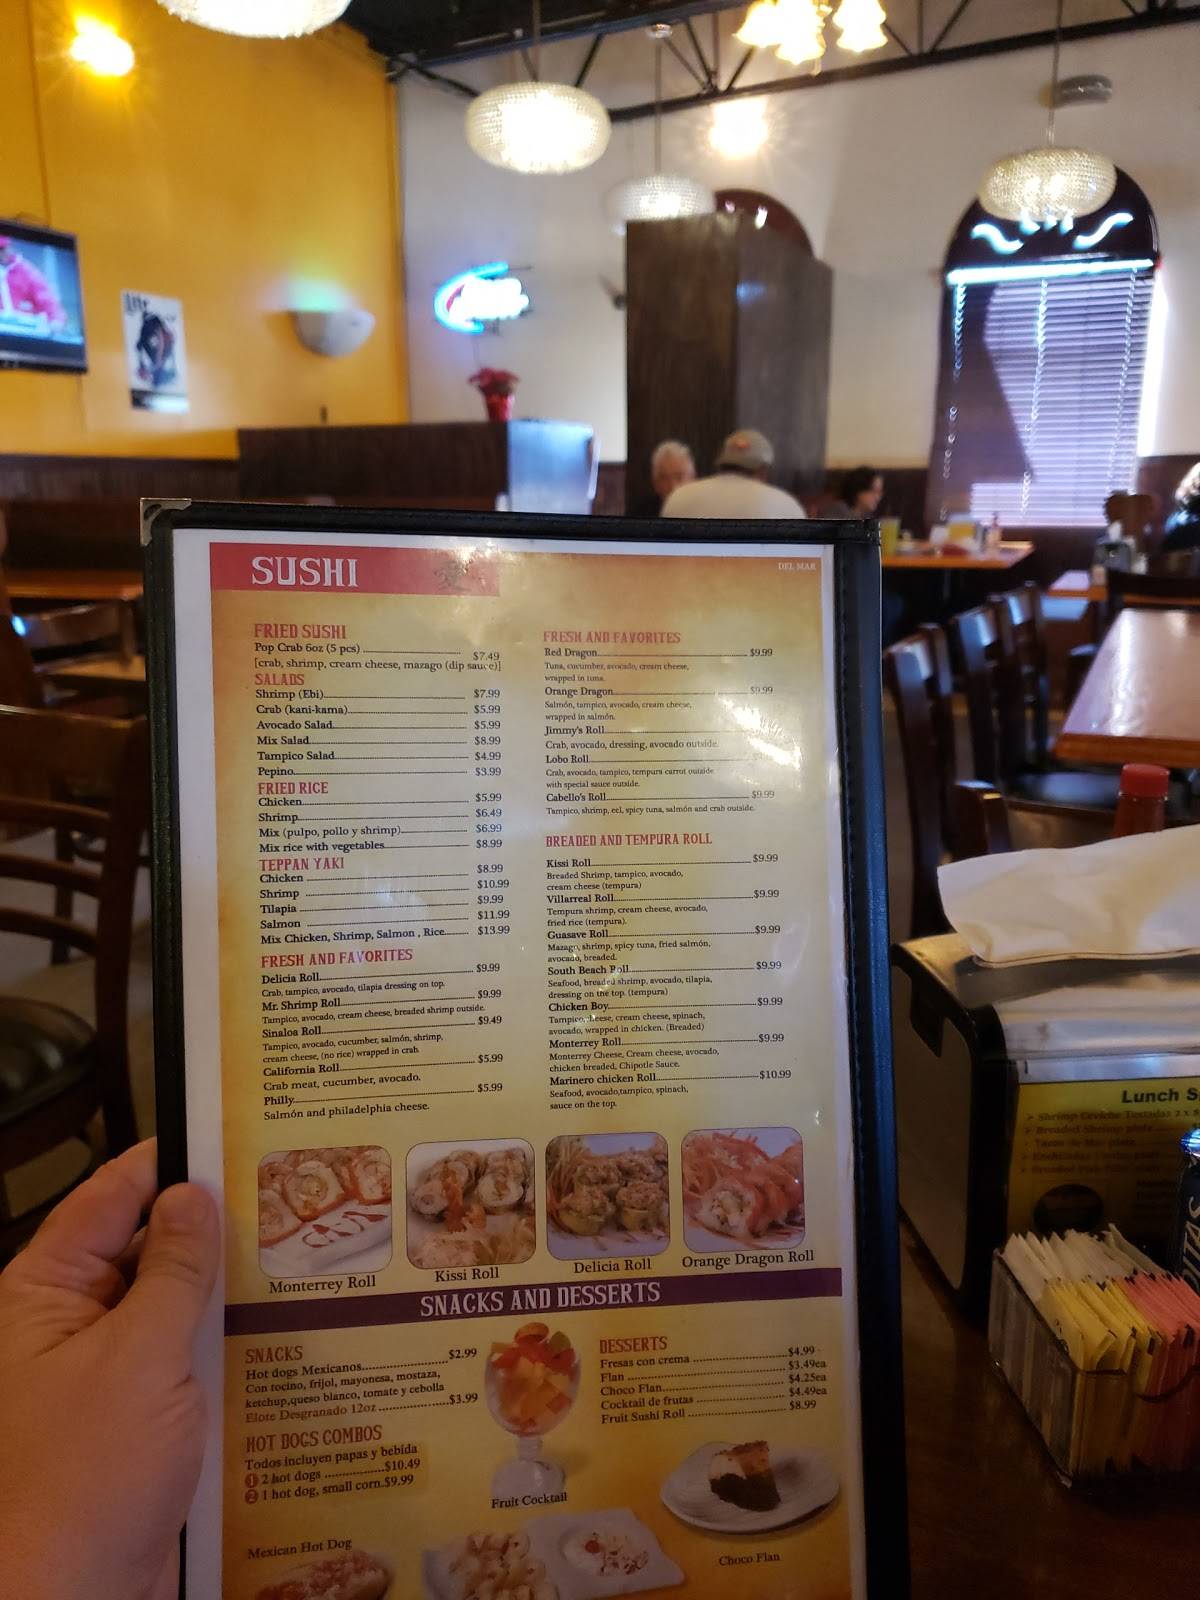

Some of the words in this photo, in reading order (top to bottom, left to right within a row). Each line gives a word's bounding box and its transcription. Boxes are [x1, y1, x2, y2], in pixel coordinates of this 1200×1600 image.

[252, 556, 358, 587] SUSHI
[778, 562, 795, 570] DEL
[797, 562, 816, 570] MAR
[254, 624, 297, 638] FRIED
[303, 625, 346, 639] SUSHI
[544, 631, 582, 643] FRESH
[586, 631, 610, 643] AND
[613, 631, 680, 644] FAVORITES
[255, 643, 274, 653] Pop
[278, 644, 302, 652] Crab
[306, 644, 323, 652] 6oz
[326, 644, 337, 653] (5
[339, 644, 360, 654] pcs)
[473, 652, 500, 661] $7.49
[545, 648, 561, 656] Red
[750, 648, 773, 657] $9.99
[286, 660, 326, 670] shrimp,
[365, 660, 400, 670] cheese,
[445, 661, 464, 671] (dip
[255, 674, 304, 686] SALADS
[256, 690, 295, 700] Shrimp
[474, 690, 500, 699] $7.99
[256, 705, 281, 714] Crab
[474, 705, 501, 714] $5.99
[570, 740, 607, 750] avocado,
[610, 739, 647, 751] dressing,
[650, 739, 684, 749] avocado
[258, 782, 295, 794] FRIED
[300, 782, 328, 794] RICE
[752, 790, 775, 799] $9.99
[260, 828, 280, 837] Mix
[323, 827, 348, 837] pollo
[352, 828, 358, 836] y
[476, 824, 502, 833] $6.99
[260, 843, 280, 852] Mix
[284, 843, 303, 852] rice
[306, 842, 328, 851] with
[476, 840, 502, 848] $8.99
[546, 835, 597, 847] BREADED
[600, 835, 622, 846] AND
[626, 834, 679, 845] TEMPURA
[683, 833, 712, 844] ROLL
[259, 858, 309, 872] TEPPAN
[315, 858, 344, 870] YAKI
[546, 859, 569, 868] Kissi
[753, 854, 778, 863] $9.99
[260, 874, 303, 883] Chicken
[477, 864, 503, 873] $8.99
[260, 889, 299, 899] Shrimp
[477, 880, 510, 888] $10.99
[574, 882, 600, 890] cheese
[602, 880, 642, 891] (tempura)
[547, 895, 592, 903] Villarreal
[754, 889, 779, 898] $9.99
[260, 904, 297, 915] Tilapia
[477, 895, 504, 904] $9.99
[260, 919, 301, 929] Salmon
[478, 910, 510, 919] $11.99
[547, 918, 566, 927] fried
[568, 918, 583, 926] rice
[261, 954, 304, 968] FRESH
[309, 952, 335, 966] AND
[339, 949, 413, 965] FAVORITES
[264, 1064, 315, 1077] California
[478, 1054, 503, 1063] $5.99
[550, 1064, 581, 1073] chicken
[619, 1060, 653, 1071] Chipotle
[264, 1082, 288, 1091] Crab
[292, 1080, 319, 1090] meat,
[322, 1077, 375, 1088] cucumber,
[550, 1075, 594, 1086] Marinero
[597, 1074, 634, 1084] chicken
[759, 1069, 791, 1080] $10.99
[1122, 1088, 1178, 1103] Lunch
[307, 1107, 326, 1117] and
[328, 1103, 391, 1118] philadelphia
[573, 1260, 620, 1274] Delicia
[625, 1258, 651, 1270] Roll
[682, 1255, 730, 1270] Orange
[735, 1252, 784, 1268] Dragon
[788, 1250, 814, 1262] Roll
[434, 1269, 466, 1283] Kissi
[471, 1267, 499, 1280] Roll
[268, 1278, 343, 1293] Monterrey
[348, 1275, 376, 1288] Roll
[420, 1291, 504, 1318] SNACKS
[510, 1283, 550, 1310] AND
[557, 1281, 661, 1309] DESSERTS
[599, 1336, 667, 1354] DESSERTS
[245, 1346, 303, 1364] SNACKS
[601, 1358, 633, 1369] Fresas
[637, 1358, 655, 1367] con
[658, 1355, 690, 1365] crema
[788, 1346, 815, 1357] $4.99
[246, 1368, 268, 1381] Hot
[271, 1367, 298, 1381] dogs
[449, 1348, 477, 1360] $2.99
[601, 1385, 635, 1397] Choco
[601, 1413, 628, 1424] Fruit
[631, 1410, 659, 1421] Sushi
[662, 1409, 685, 1420] Roll
[789, 1400, 817, 1410] $8.99
[246, 1436, 276, 1453] HOT
[281, 1432, 319, 1449] DOGS
[323, 1424, 383, 1445] COMBOS
[245, 1458, 281, 1471] Todos
[284, 1453, 331, 1468] incluyen
[335, 1450, 368, 1464] papas
[371, 1449, 378, 1460] y
[381, 1443, 417, 1457] bebida
[491, 1496, 519, 1509] Fruit
[522, 1491, 567, 1505] Cocktail
[248, 1545, 297, 1559] Mexican
[300, 1542, 323, 1553] Hot
[327, 1539, 352, 1553] Dog
[718, 1554, 753, 1567] Choco
[757, 1551, 780, 1563] Flan
